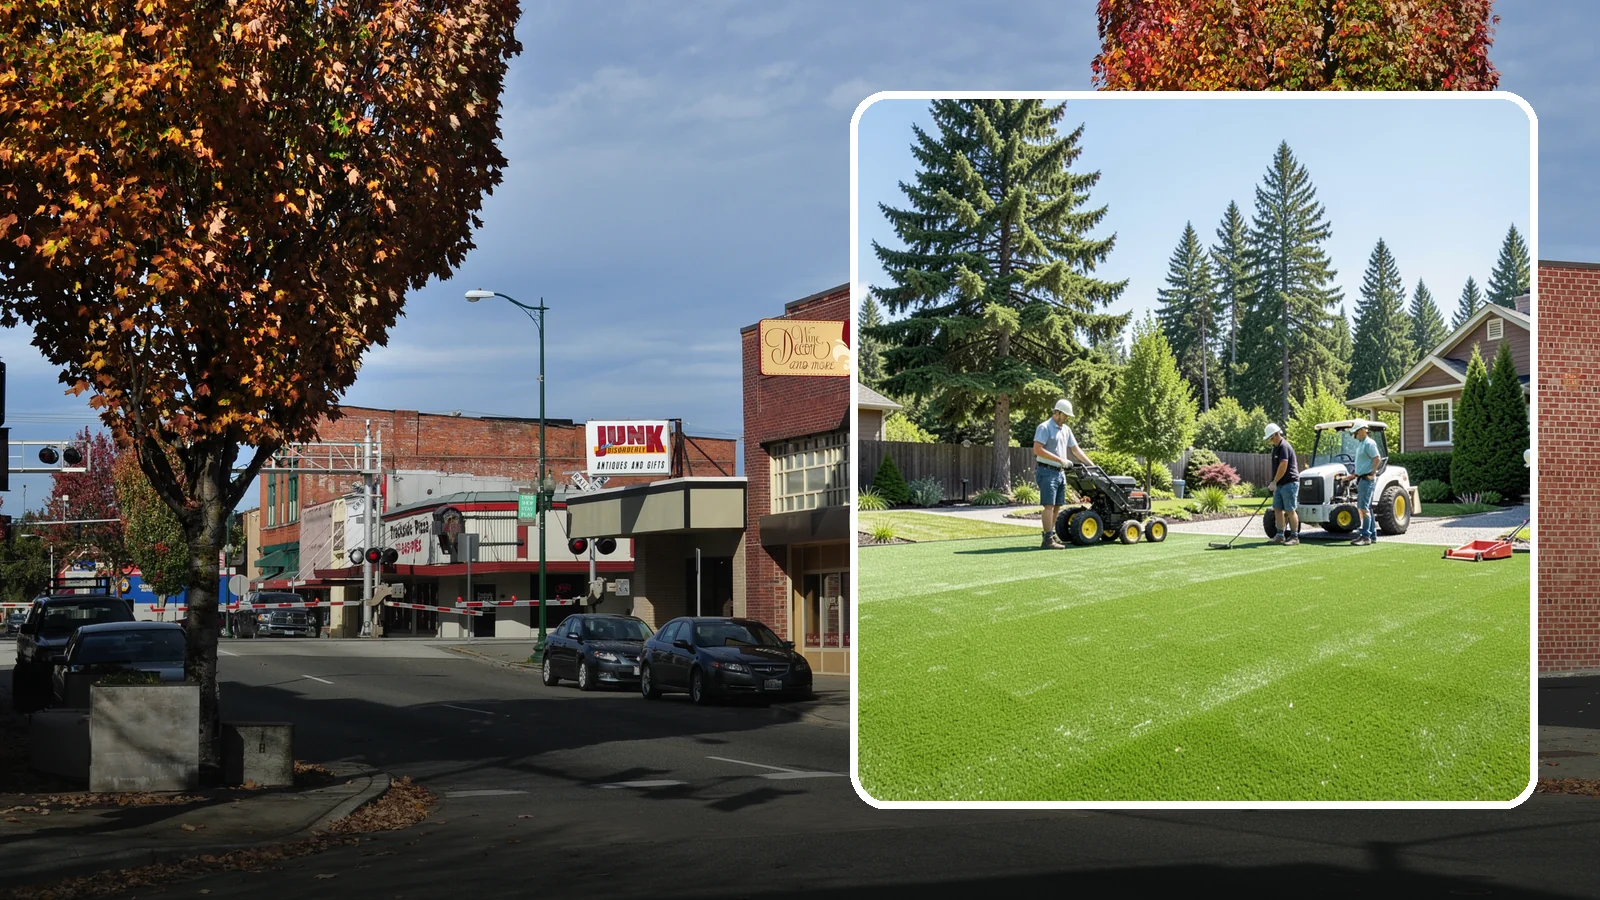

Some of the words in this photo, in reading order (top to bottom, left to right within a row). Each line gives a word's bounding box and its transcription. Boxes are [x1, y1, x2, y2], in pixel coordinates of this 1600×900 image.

[595, 425, 665, 457] JUNK
[607, 446, 645, 454] DISORDERLY
[597, 461, 628, 470] ANTIQUES
[631, 461, 644, 470] AND
[647, 460, 665, 469] GIFTS
